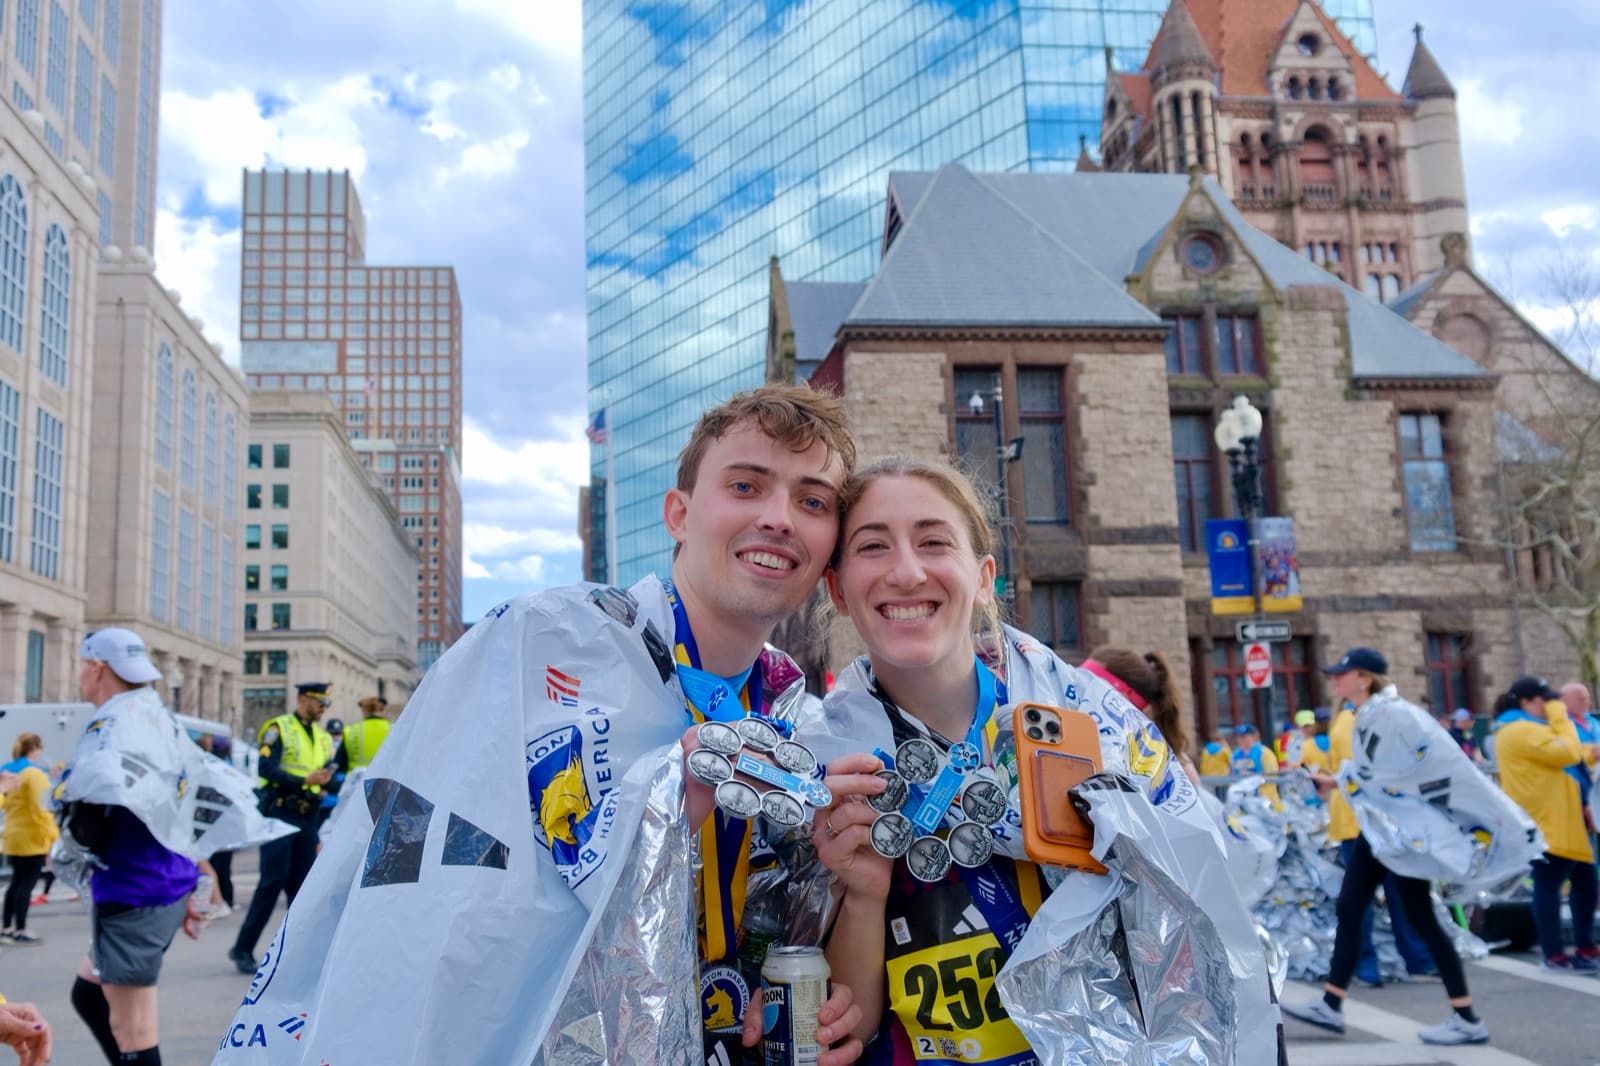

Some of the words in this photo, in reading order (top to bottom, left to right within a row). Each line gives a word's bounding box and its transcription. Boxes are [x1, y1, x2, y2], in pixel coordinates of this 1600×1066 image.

[700, 971, 722, 991] OSTON
[904, 947, 1010, 1031] 252
[219, 1023, 267, 1050] ICA
[919, 1038, 935, 1053] 2
